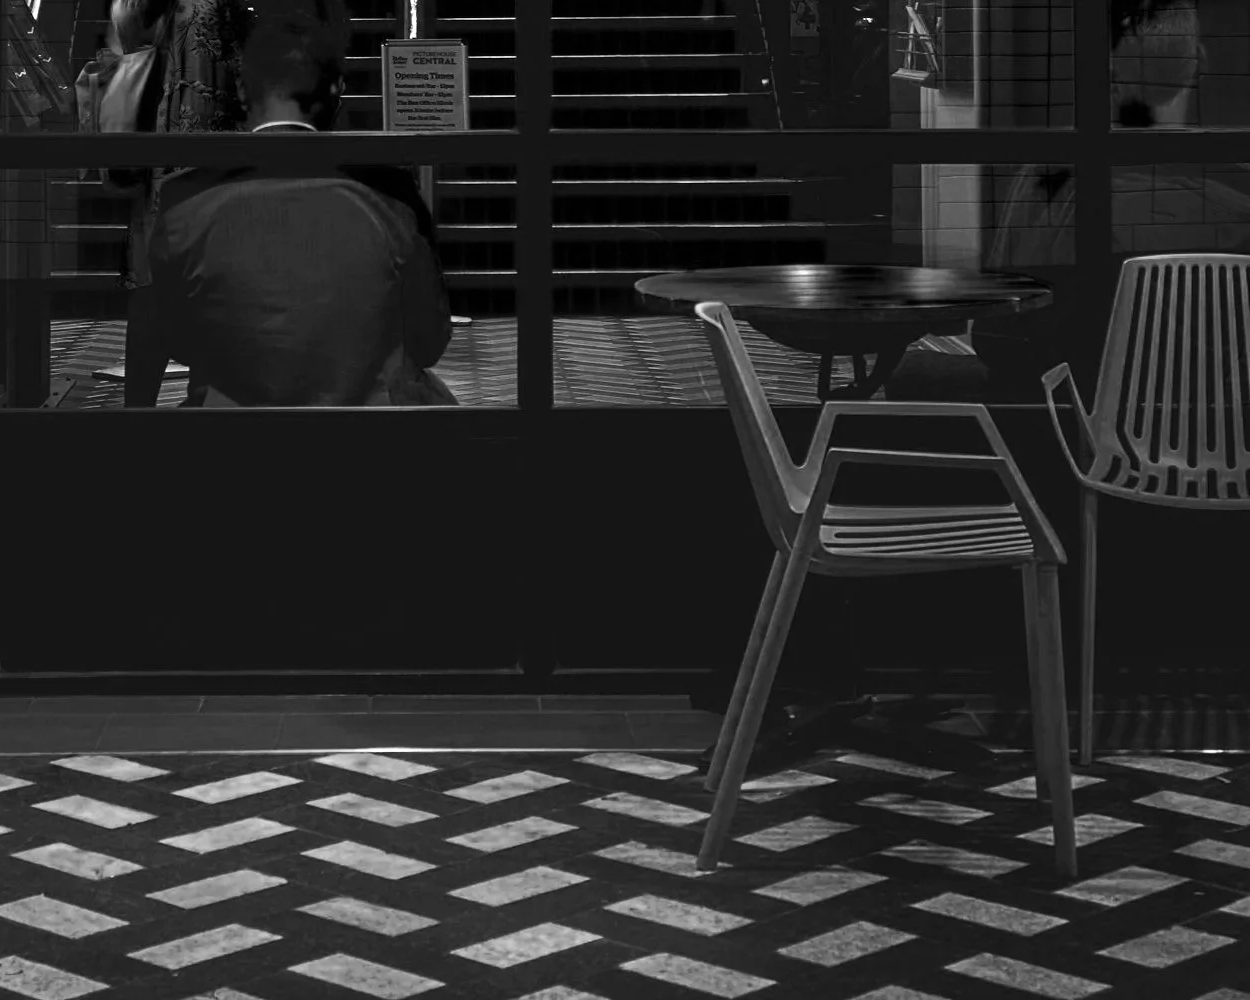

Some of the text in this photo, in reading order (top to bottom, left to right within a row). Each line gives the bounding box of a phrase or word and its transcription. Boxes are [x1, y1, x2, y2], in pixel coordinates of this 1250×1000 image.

[413, 57, 457, 65] CENTRAL
[395, 72, 455, 81] Opening Times
